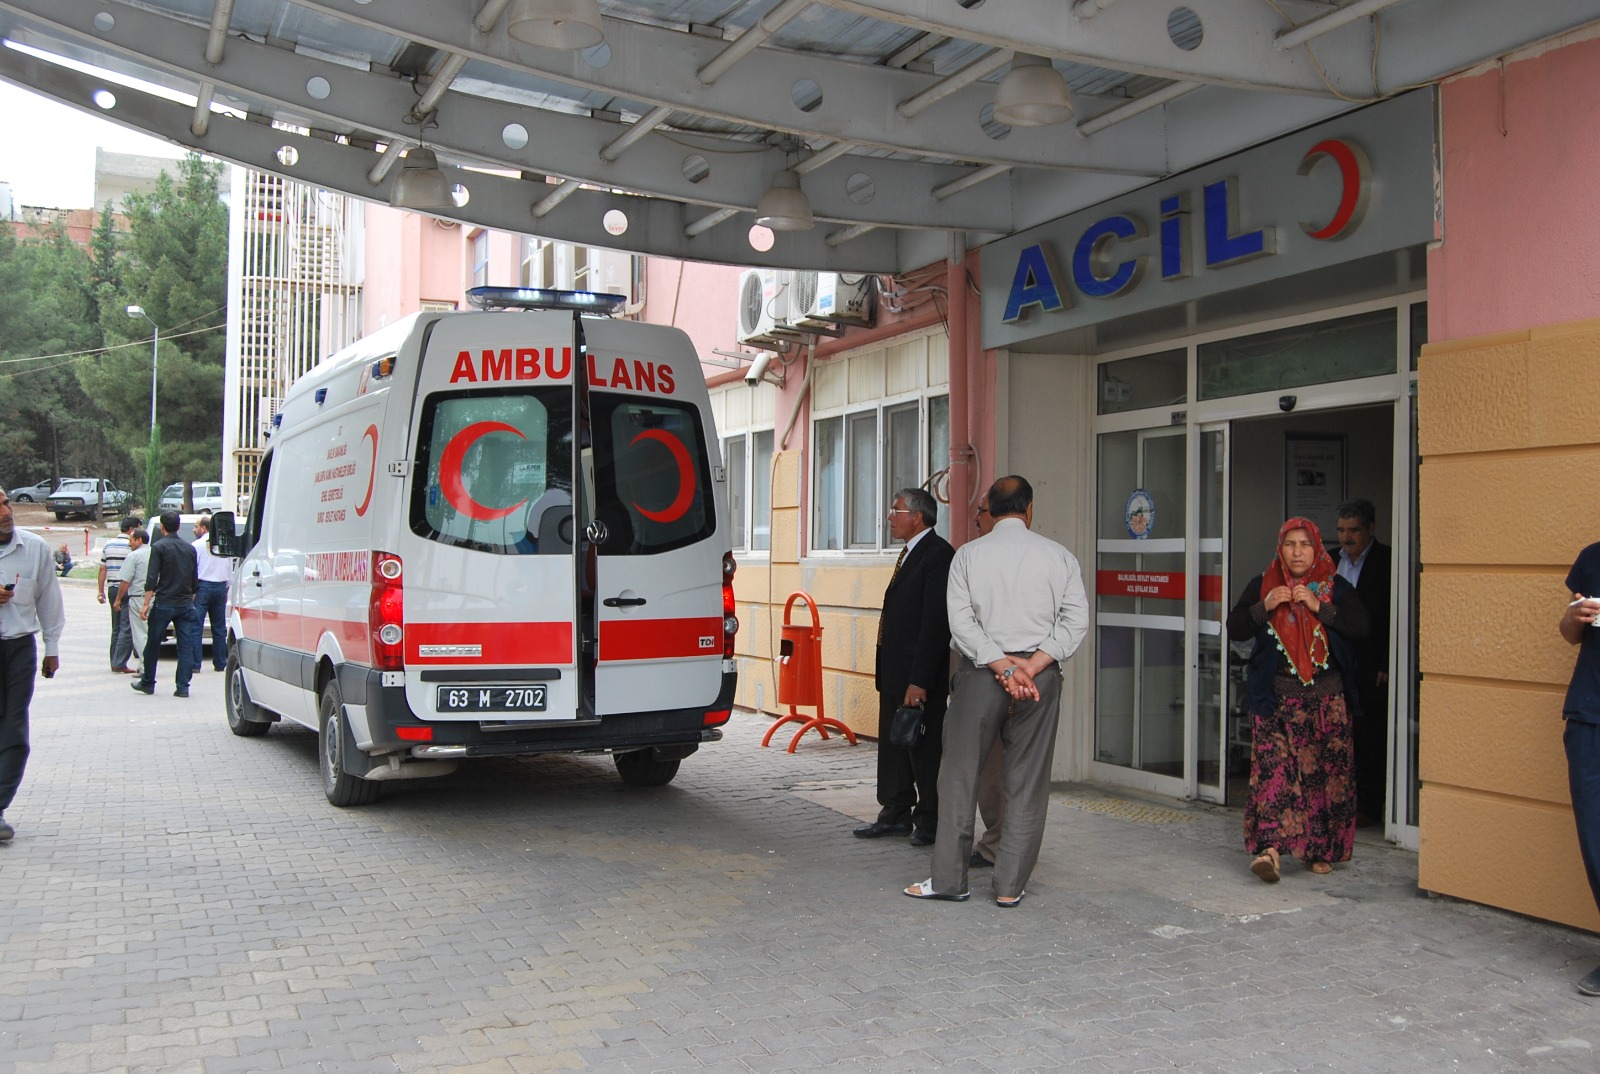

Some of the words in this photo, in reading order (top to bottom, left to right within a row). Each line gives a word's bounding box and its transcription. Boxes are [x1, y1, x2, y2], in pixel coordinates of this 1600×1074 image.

[1002, 179, 1268, 323] ACİL
[449, 690, 468, 708] 63
[478, 690, 491, 708] M
[505, 690, 544, 707] 2702
